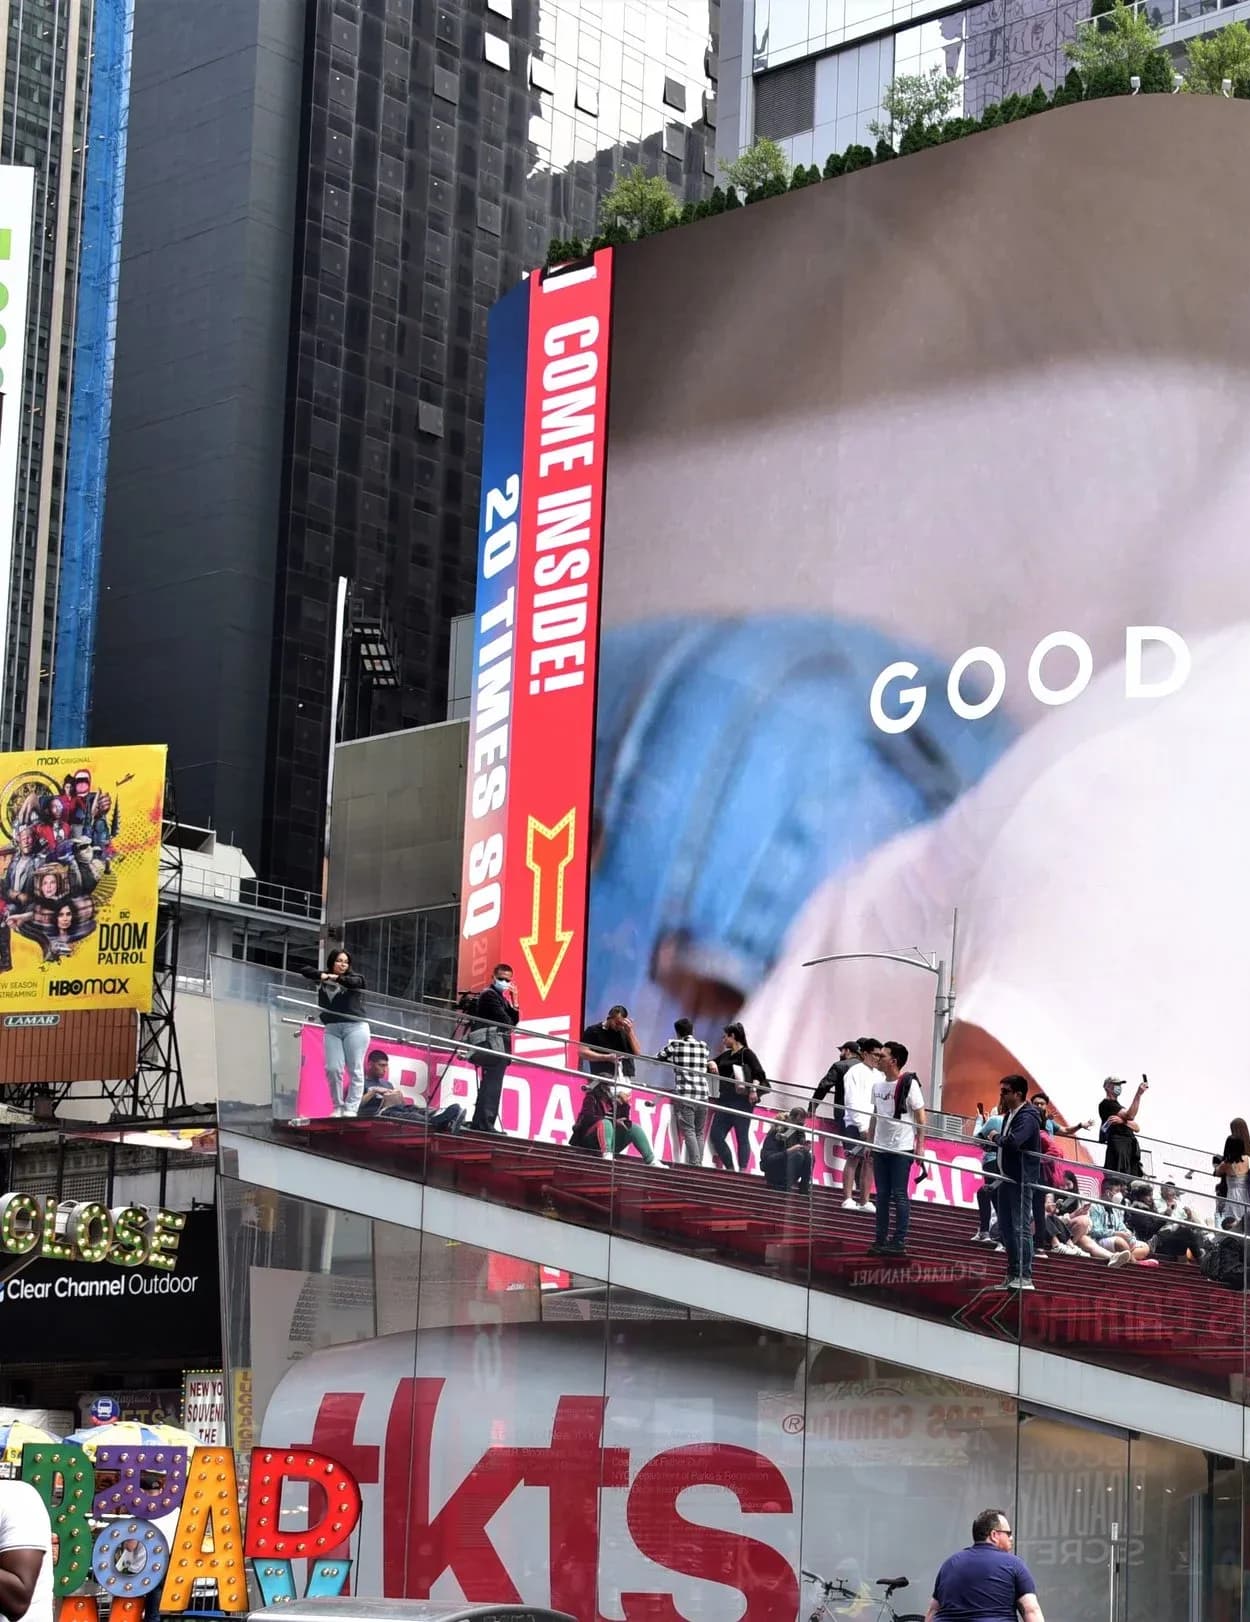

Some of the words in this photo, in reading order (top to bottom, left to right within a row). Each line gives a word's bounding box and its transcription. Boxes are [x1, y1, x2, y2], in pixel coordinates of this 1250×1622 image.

[539, 314, 600, 478] COME
[483, 473, 520, 580] 20
[528, 484, 593, 696] INSIDE!
[472, 586, 517, 820] TIMES
[869, 624, 1192, 735] GOOD
[99, 922, 149, 952] DOOM
[463, 840, 504, 941] SQ
[97, 951, 147, 965] PATROL
[8, 1015, 56, 1026] LAMAR
[7, 1278, 52, 1300] Clear
[54, 1274, 125, 1298] Channel
[128, 1273, 199, 1296] Outdoor
[187, 1403, 226, 1423] SOUVENI
[190, 1381, 210, 1397] NEW
[212, 1381, 223, 1397] YO
[291, 1377, 801, 1622] tkts
